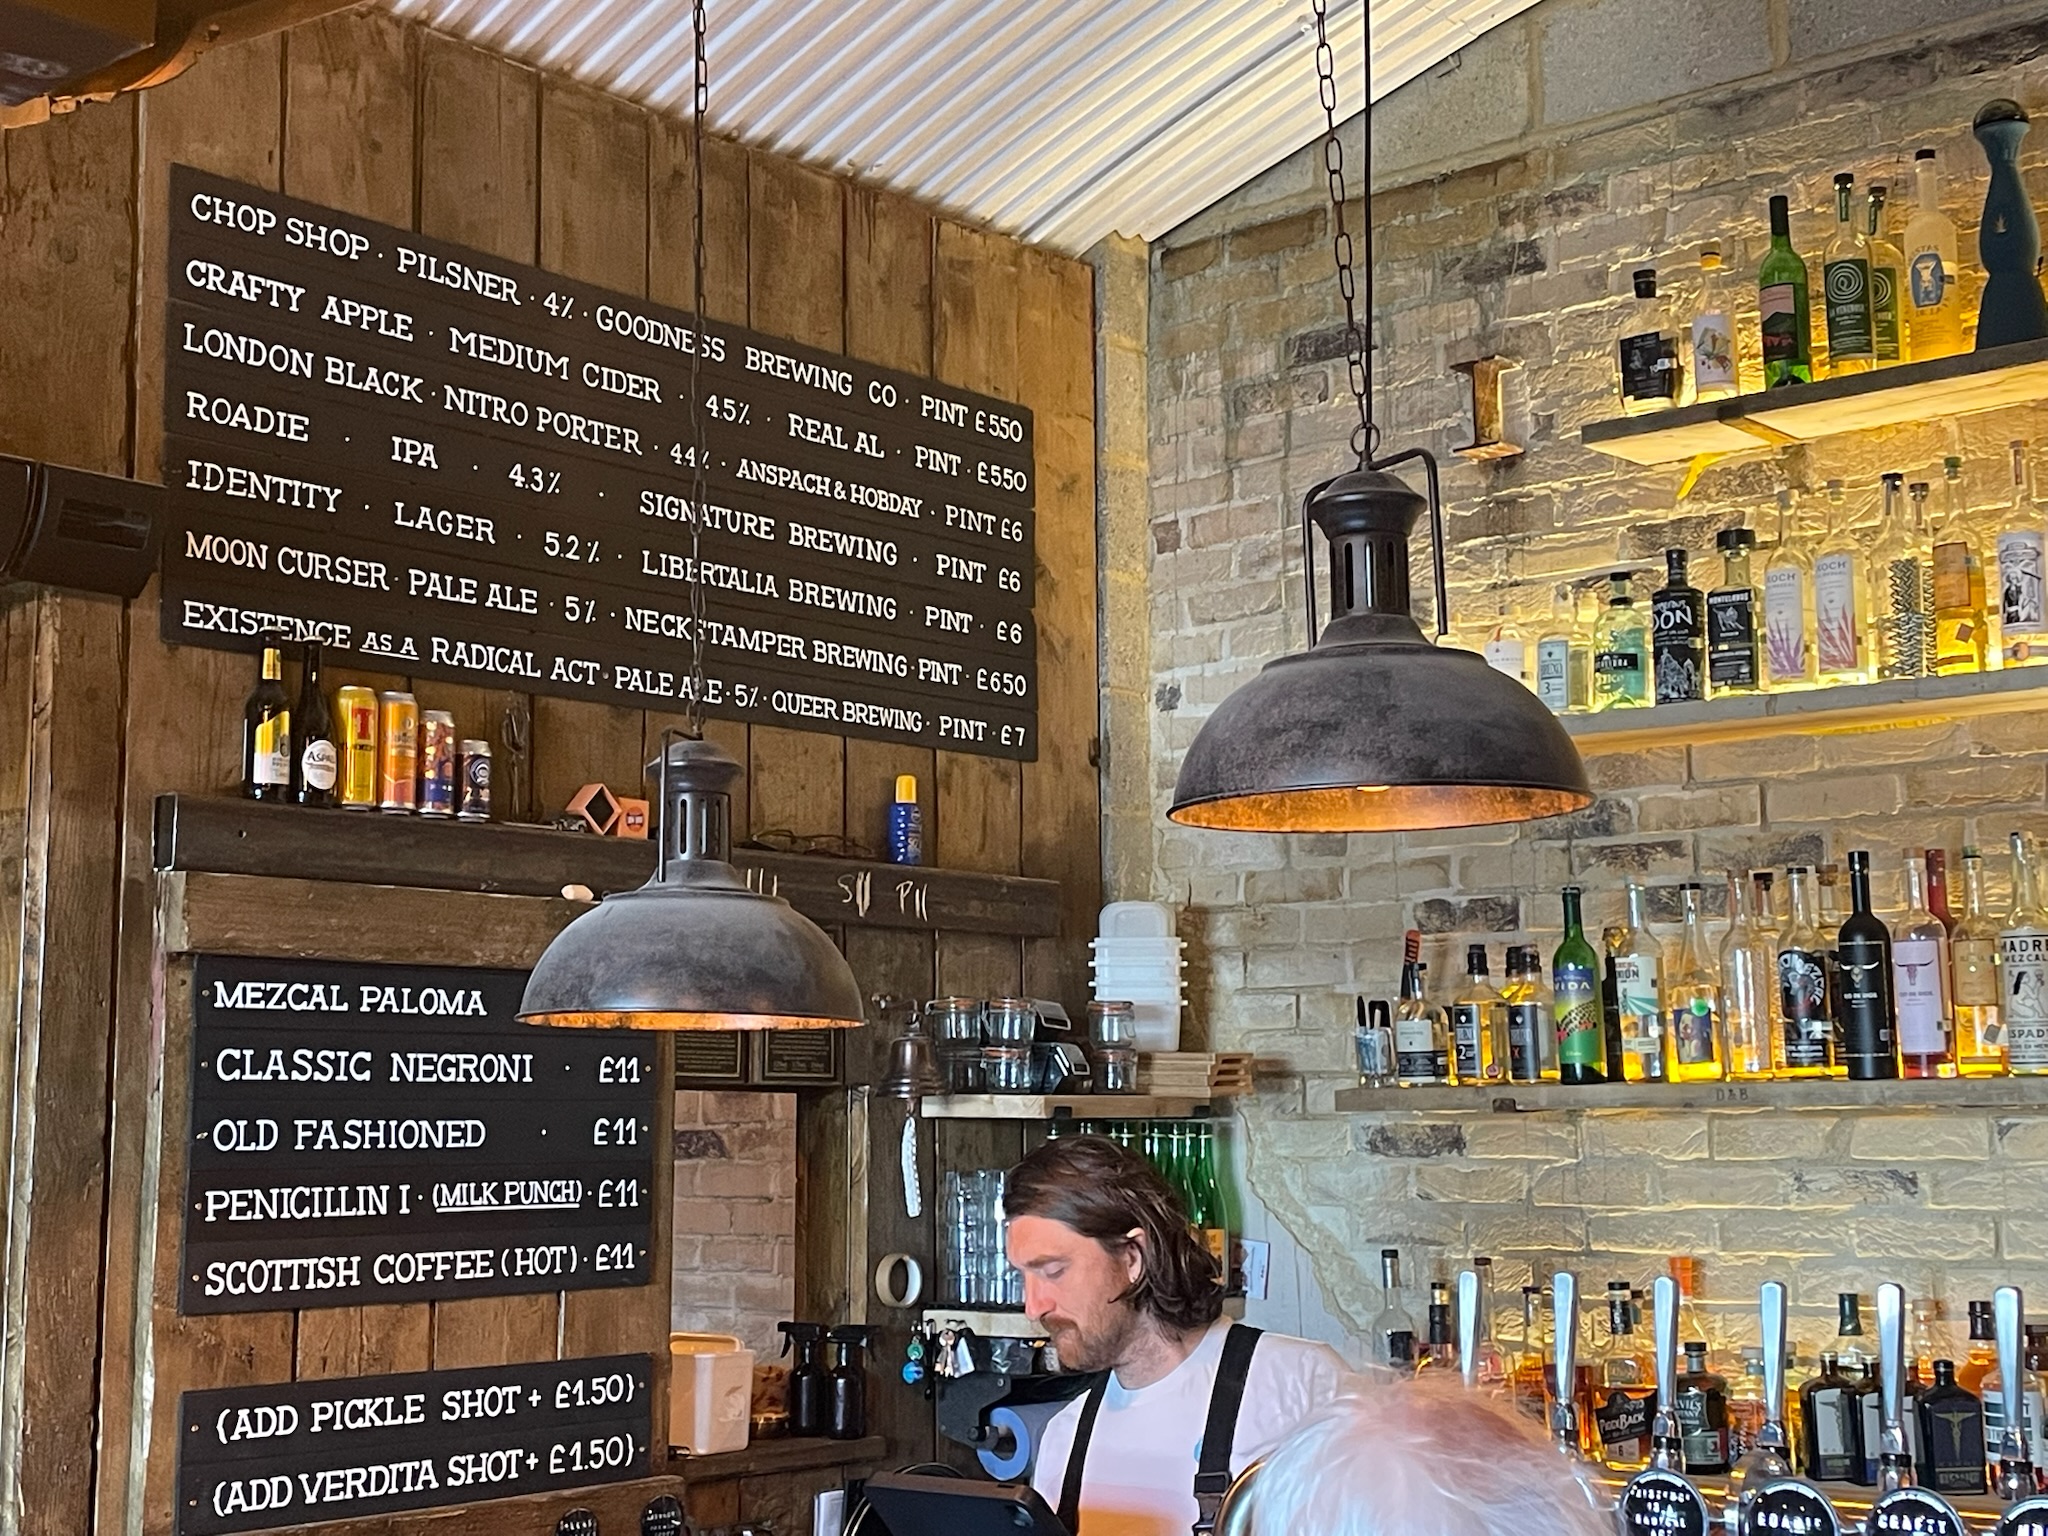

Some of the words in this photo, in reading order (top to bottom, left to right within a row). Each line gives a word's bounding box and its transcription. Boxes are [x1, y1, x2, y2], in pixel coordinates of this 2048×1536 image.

[185, 259, 305, 312] CRAFTY
[321, 295, 414, 342] APPLE
[449, 327, 570, 380] MEDIUM
[582, 362, 662, 403] CIDER
[788, 412, 849, 449] REAL
[854, 431, 885, 459] AL
[914, 445, 962, 476] PINT
[191, 193, 276, 235] CHOP
[285, 217, 369, 259] SHOP
[397, 246, 521, 305] PILSNER
[543, 291, 574, 320] 4%
[596, 305, 726, 362] GOODNESS
[744, 345, 853, 396] BREWING
[868, 380, 897, 408] CO
[920, 394, 968, 428] PINT
[182, 322, 314, 379] LONDON
[324, 356, 424, 404] BLACK
[443, 384, 529, 427] NITRO
[536, 406, 643, 455] PORTER
[736, 458, 832, 498] ANSPACH
[834, 481, 847, 500] &
[850, 484, 923, 519] HOBDAY
[945, 504, 996, 536] PINT
[1001, 517, 1023, 542] £6
[186, 391, 309, 442] ROADIE
[391, 435, 439, 470] IPA
[508, 463, 561, 494] 4.3%
[639, 490, 774, 540] SIGNATURE
[788, 522, 897, 566] BREWING
[935, 553, 987, 584] PINT
[998, 567, 1021, 592] £6
[185, 530, 268, 570] MOON
[277, 546, 389, 591] CURSER
[408, 568, 477, 605] PALE
[485, 583, 538, 615] ALE
[565, 595, 597, 624] 5%
[812, 639, 907, 678] BREWING
[917, 658, 963, 686] PINT
[186, 459, 343, 512] IDENTITY
[394, 501, 496, 545] LAGER
[642, 550, 779, 597] LIBERTALIA
[788, 578, 897, 620] BREWING
[925, 605, 973, 634] PINT
[996, 620, 1022, 644] £6
[182, 599, 352, 649] EXISTENCE
[361, 631, 392, 652] AS
[400, 636, 418, 656] A
[431, 636, 541, 678] RADICAL
[550, 656, 600, 686] ACT
[614, 665, 674, 697] PALE
[678, 676, 723, 705] AE
[734, 683, 759, 708] 5%
[771, 690, 840, 721] QUEER
[842, 700, 923, 733] BREWING
[938, 715, 987, 742] PINT
[1000, 724, 1026, 747] £7
[213, 981, 349, 1012] MEZCAL
[359, 985, 487, 1016] PALOMA
[216, 1048, 372, 1082] CLASSIC
[389, 1052, 534, 1083] NEGRONI
[598, 1056, 641, 1083] £11
[212, 1119, 279, 1152] OLD
[293, 1119, 486, 1150] FASHIONED
[593, 1117, 637, 1145] £11
[204, 1184, 390, 1222] PENICILLIN
[432, 1181, 499, 1208] (MILK
[504, 1179, 583, 1206] PUNCH)
[598, 1178, 639, 1208] £11
[204, 1255, 362, 1296] SCOTTISH
[373, 1249, 494, 1285] COFFEE
[595, 1242, 635, 1271] £11
[215, 1404, 299, 1445] (ADD
[309, 1393, 425, 1433] PICKLE
[555, 1373, 635, 1409] £1.50)
[212, 1475, 293, 1517] (ADD
[299, 1459, 440, 1505] VERDITA
[549, 1433, 635, 1475] £1.50)
